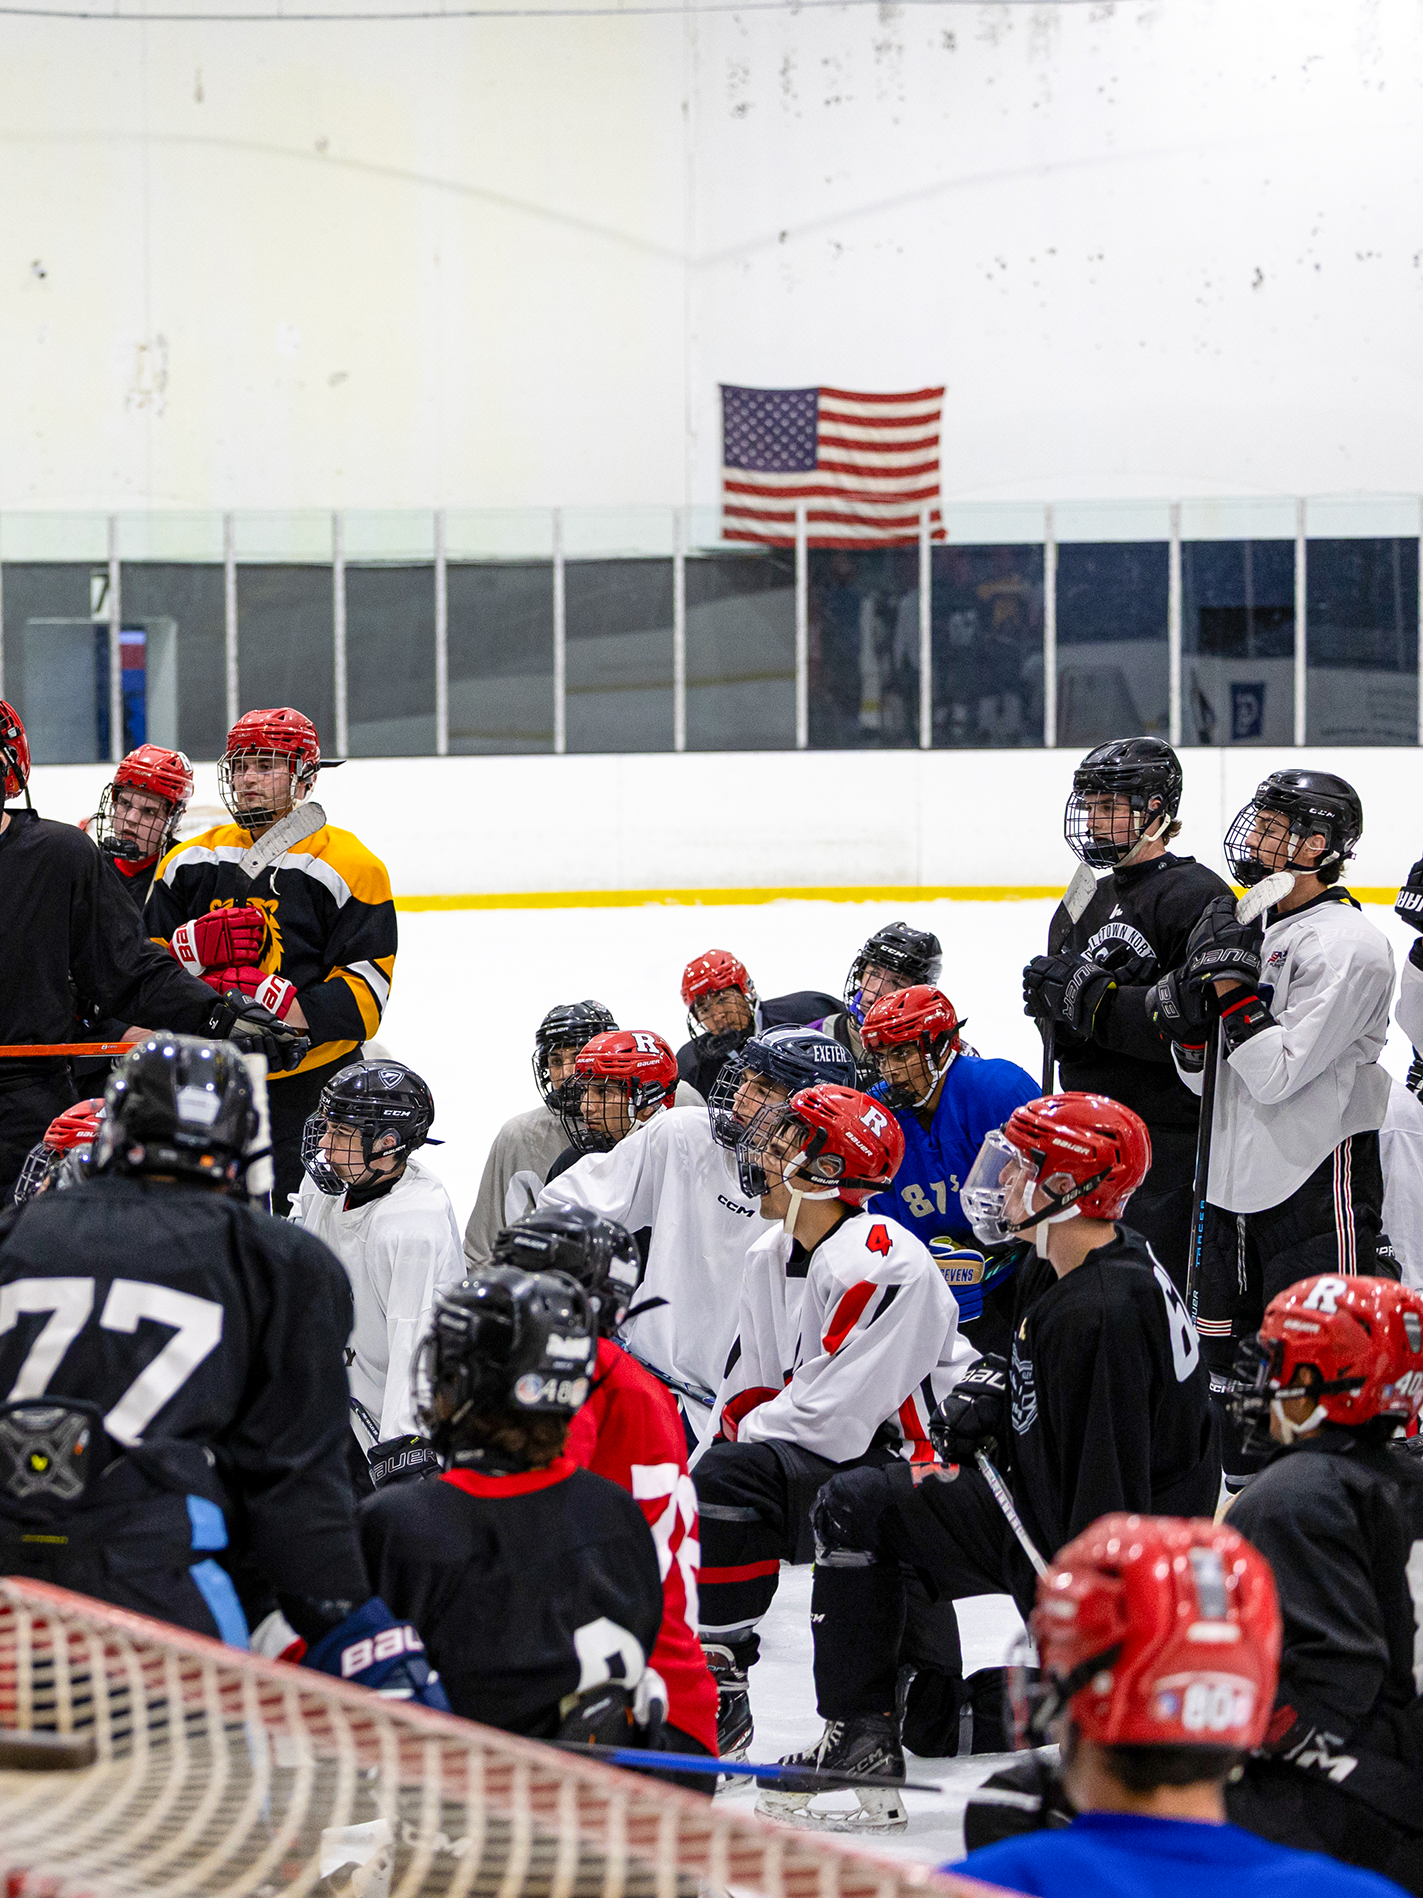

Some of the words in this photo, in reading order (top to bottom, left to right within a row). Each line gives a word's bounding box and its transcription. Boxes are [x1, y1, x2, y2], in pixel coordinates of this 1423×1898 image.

[879, 944, 906, 958] CCM
[1128, 927, 1159, 958] NORT
[1191, 948, 1262, 972] AUER
[1062, 962, 1102, 1021] AUER
[546, 1026, 569, 1036] BAUER
[631, 1033, 661, 1055] R
[813, 1044, 847, 1063] EXETER
[636, 1058, 661, 1068] BAUER
[383, 1109, 412, 1118] CCM
[859, 1105, 889, 1138] R
[845, 1131, 874, 1157] BAUER
[1052, 1137, 1091, 1156] BAUER
[810, 1175, 840, 1185] BAUER
[717, 1194, 756, 1218] CCM
[864, 1223, 894, 1258] 4
[1195, 1200, 1206, 1268] TRACER
[1302, 1277, 1348, 1314] R
[1191, 1290, 1199, 1327] AUER
[344, 1347, 356, 1367] Y
[341, 1625, 425, 1679] BAU
